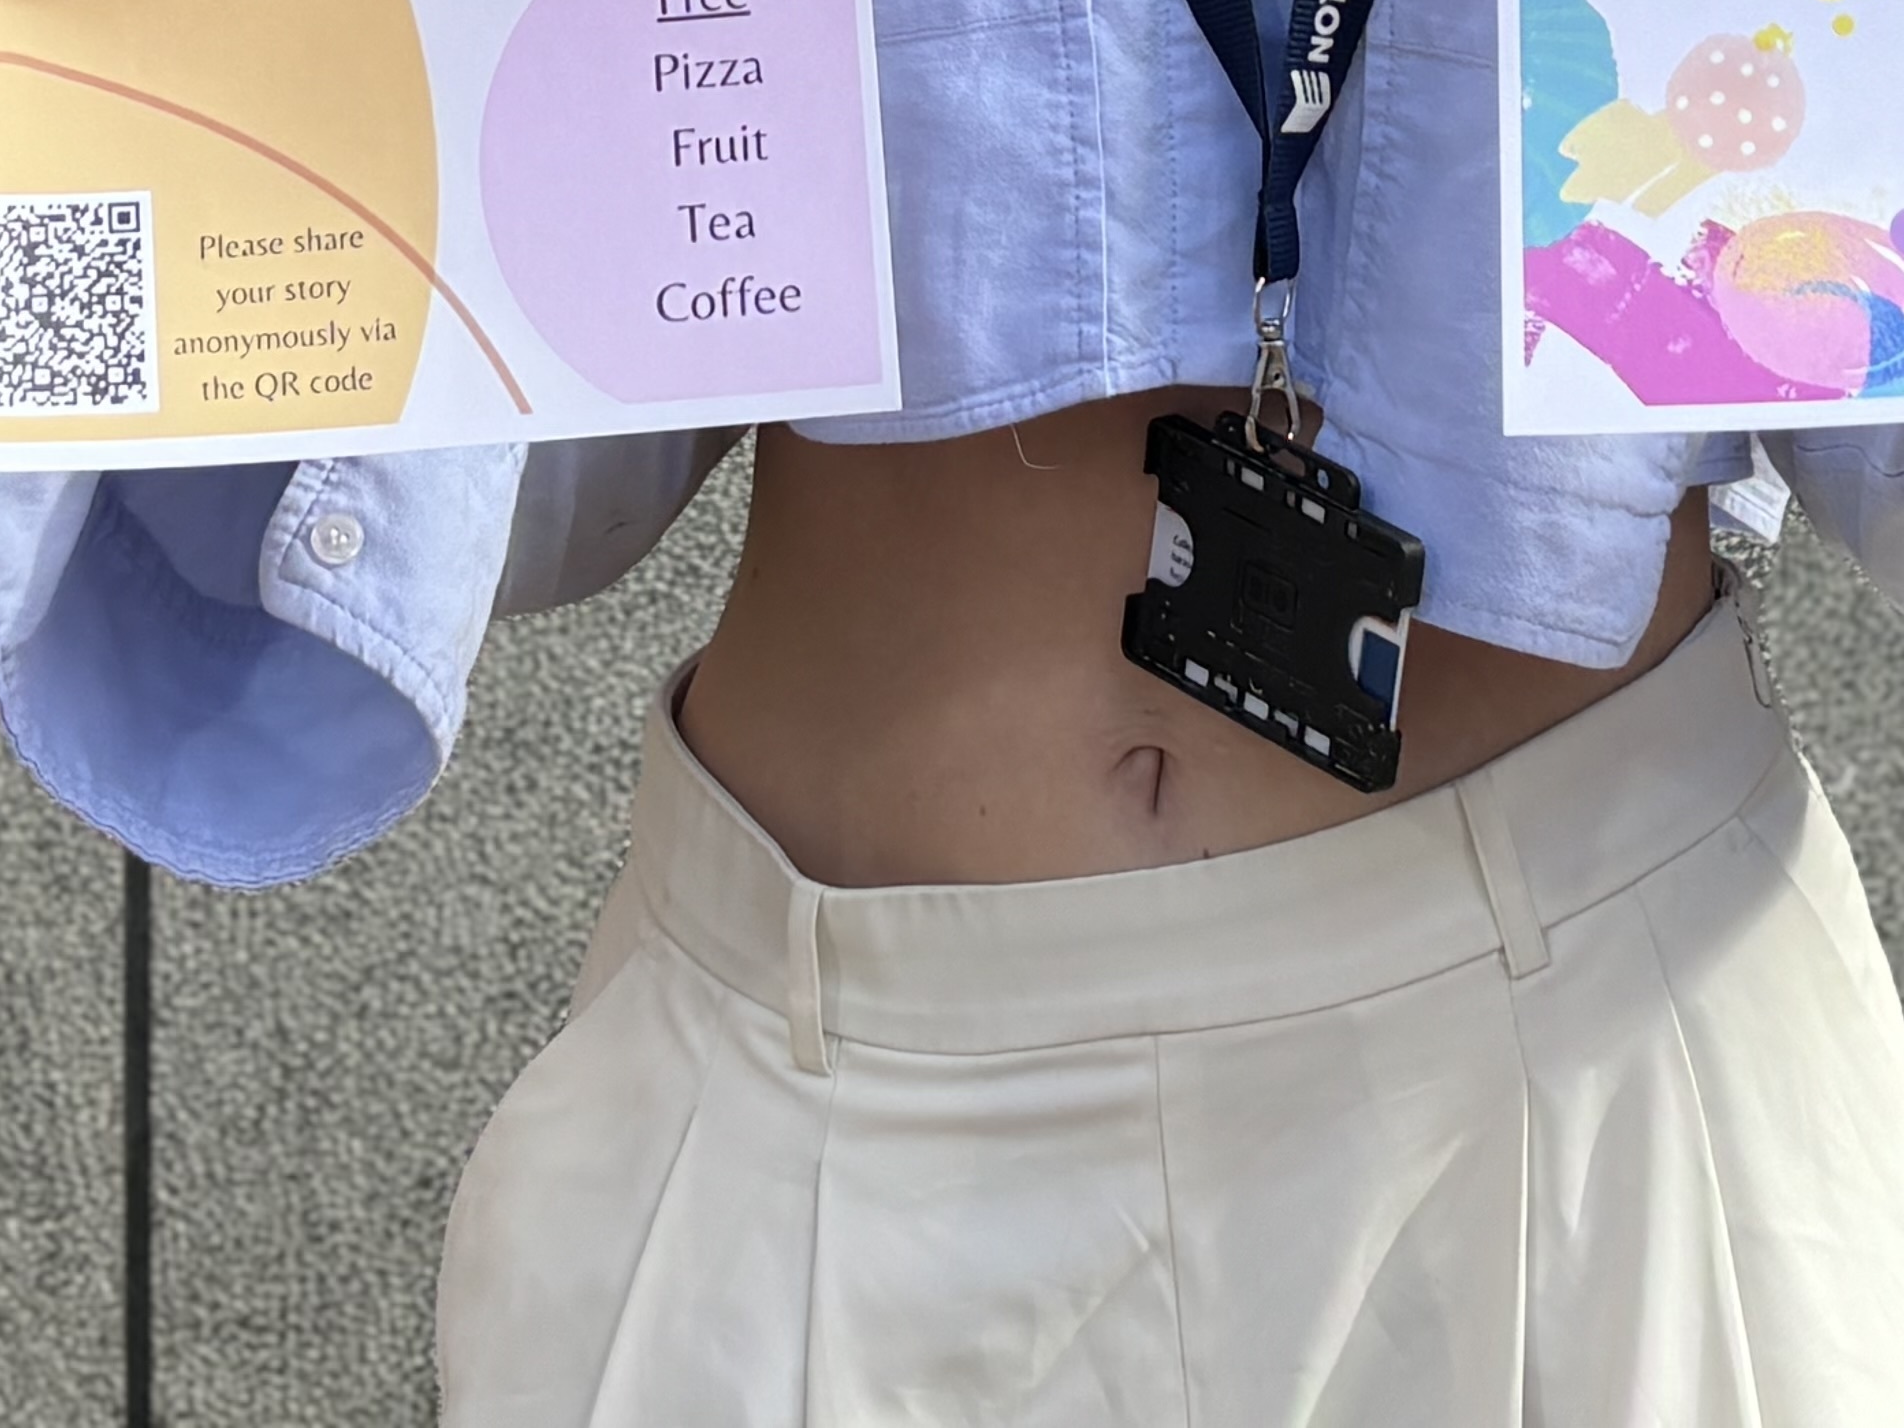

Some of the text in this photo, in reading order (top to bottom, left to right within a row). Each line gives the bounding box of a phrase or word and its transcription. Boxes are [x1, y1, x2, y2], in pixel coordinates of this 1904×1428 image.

[654, 52, 764, 93] Pizza
[673, 124, 768, 167] Fruit
[200, 227, 364, 260] Please share
[677, 203, 756, 244] Tea
[216, 280, 351, 314] your story
[656, 275, 801, 322] Coffee
[173, 317, 397, 360] anonymously via
[201, 365, 373, 402] the QR code
